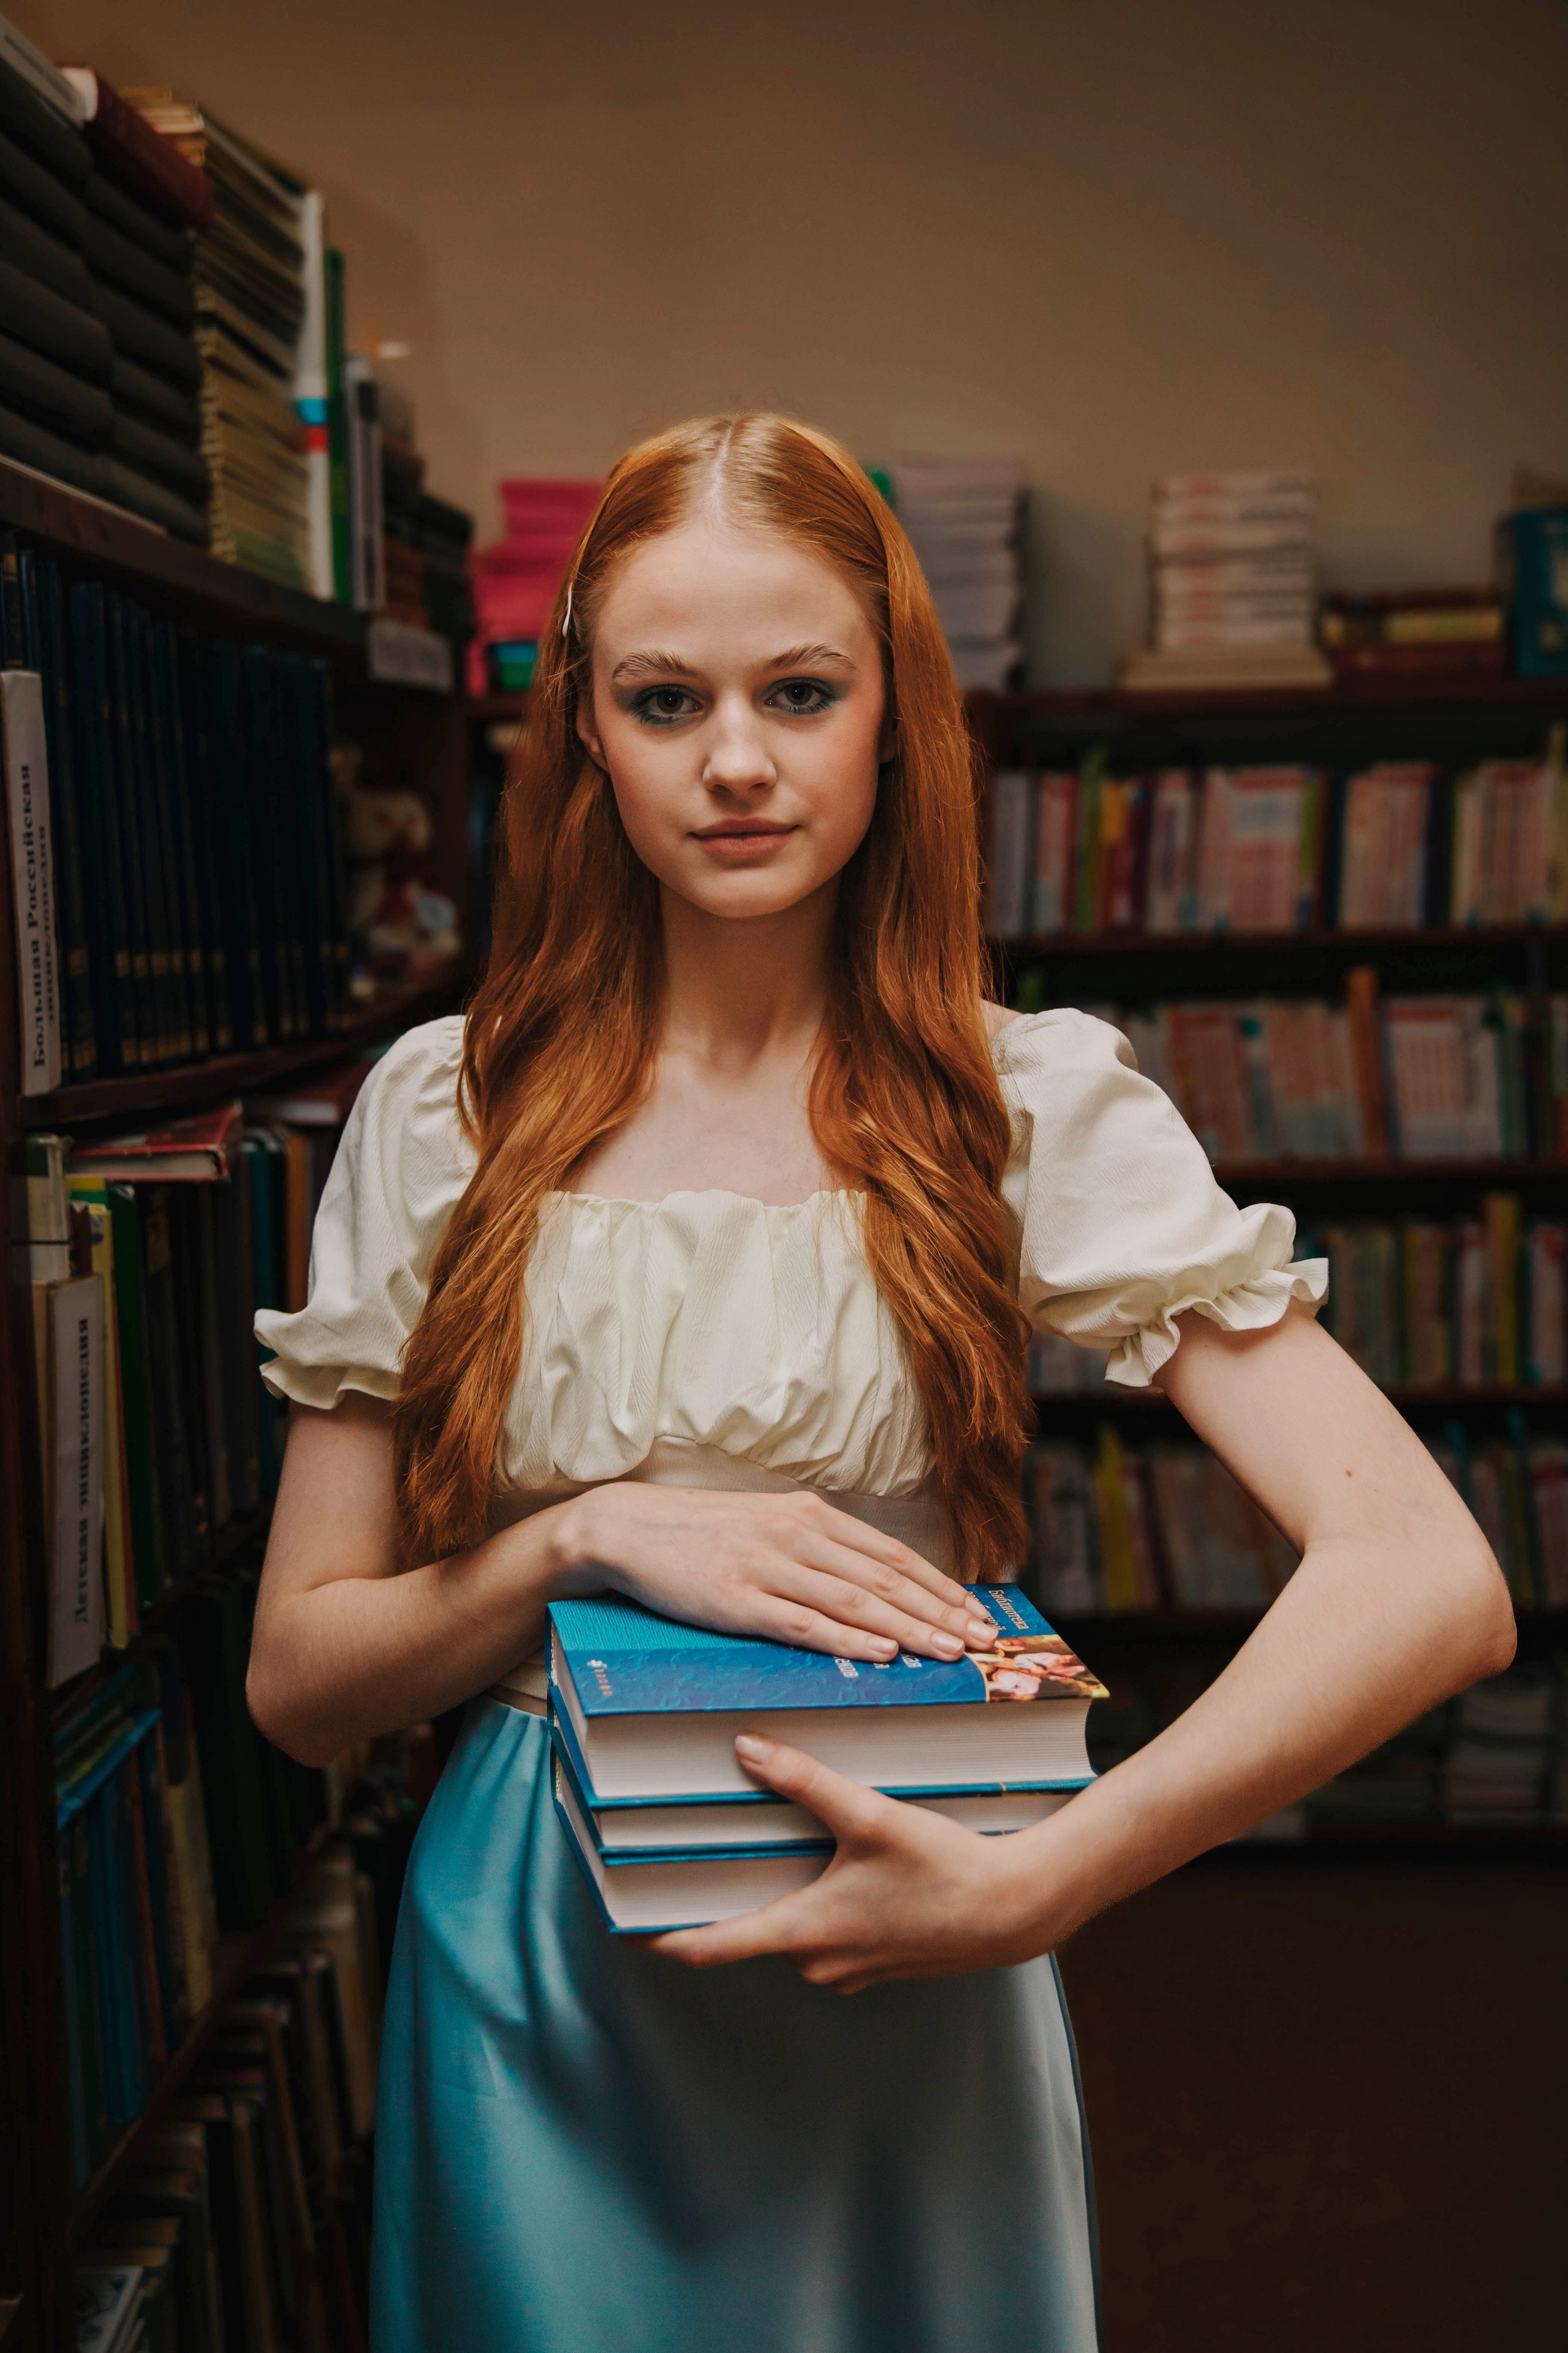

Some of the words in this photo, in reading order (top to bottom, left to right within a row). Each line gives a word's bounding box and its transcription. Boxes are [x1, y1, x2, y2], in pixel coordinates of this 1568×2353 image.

[21, 765, 38, 927] Российская
[34, 940, 45, 1066] Большая
[78, 1318, 89, 1511] энциклопедия
[74, 1518, 89, 1624] Детская
[988, 1589, 1029, 1630] Библиотека
